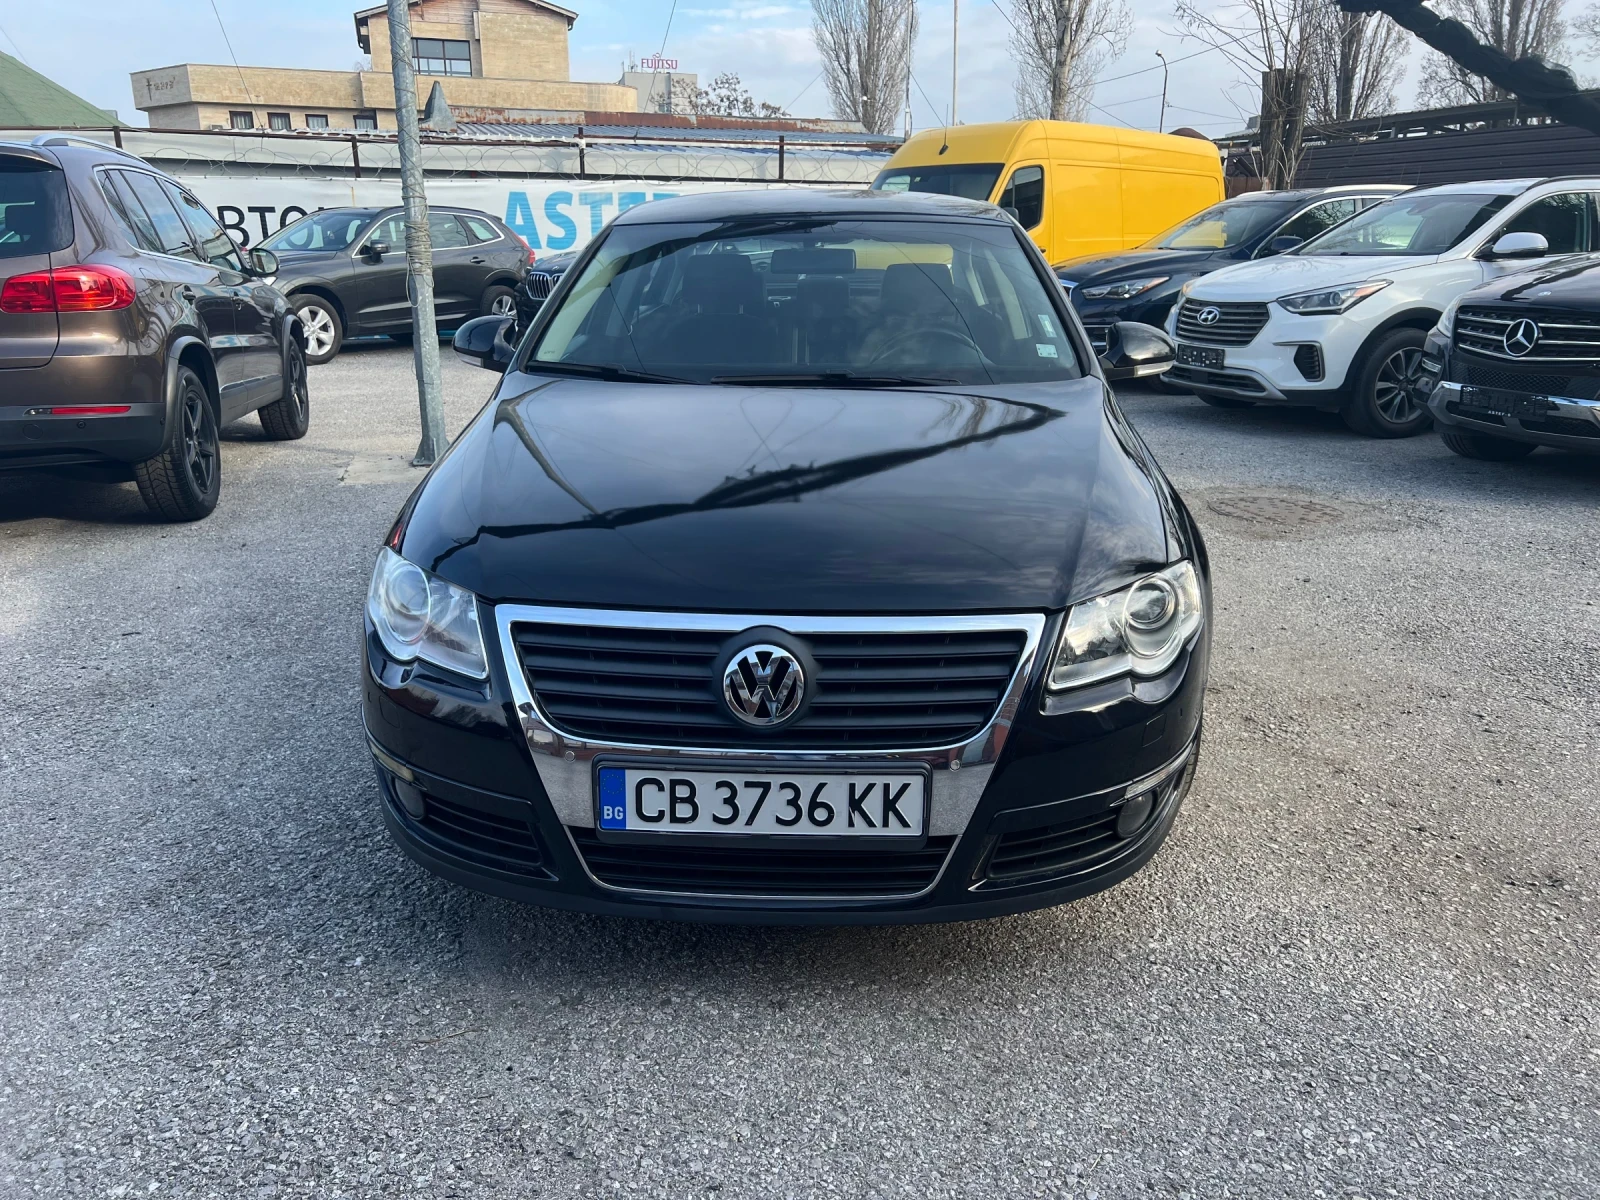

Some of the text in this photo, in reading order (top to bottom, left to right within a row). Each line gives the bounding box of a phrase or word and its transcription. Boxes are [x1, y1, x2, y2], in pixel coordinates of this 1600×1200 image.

[641, 58, 678, 70] FUJITSU
[504, 191, 680, 250] AST
[603, 805, 624, 820] BG
[635, 777, 912, 828] CB 3736 KK
